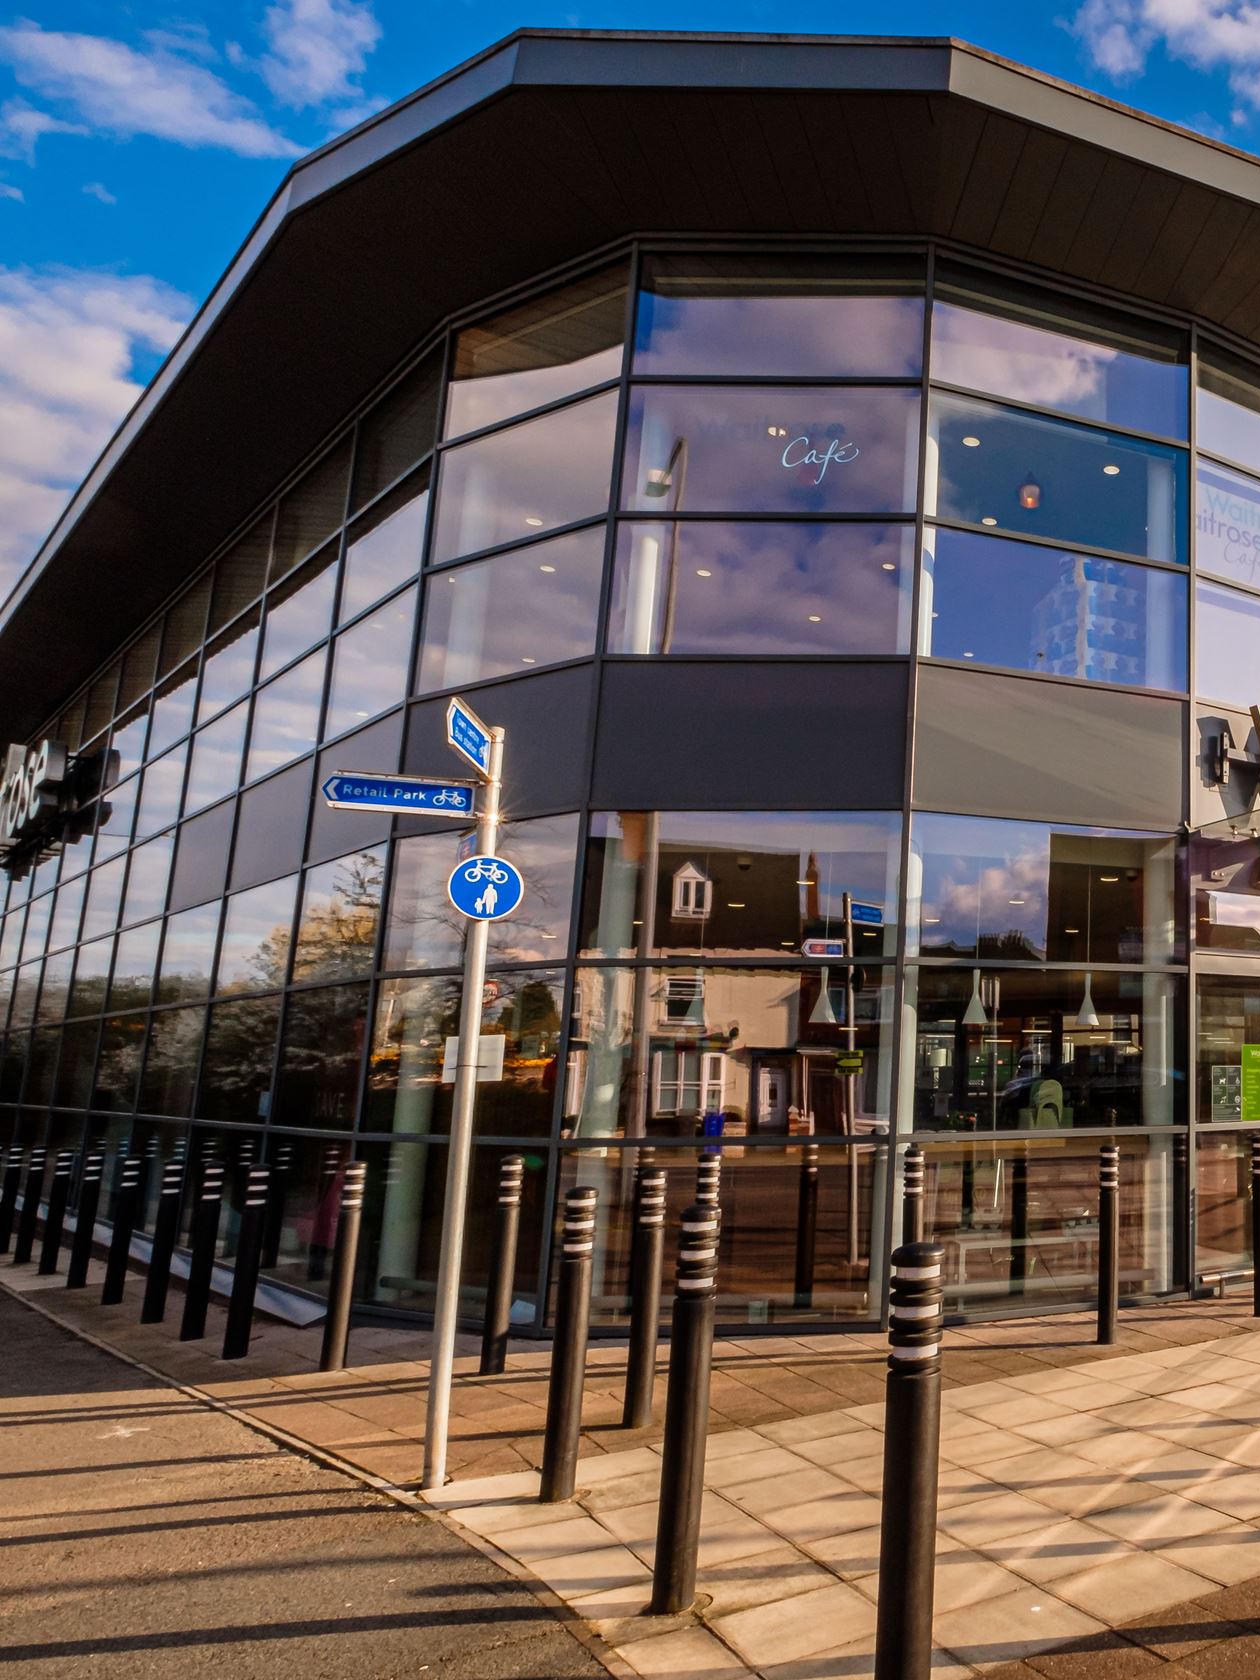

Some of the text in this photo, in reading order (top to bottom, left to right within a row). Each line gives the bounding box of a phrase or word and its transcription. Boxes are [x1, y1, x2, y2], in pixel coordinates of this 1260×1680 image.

[781, 436, 860, 485] Café
[343, 783, 427, 801] Retail Park
